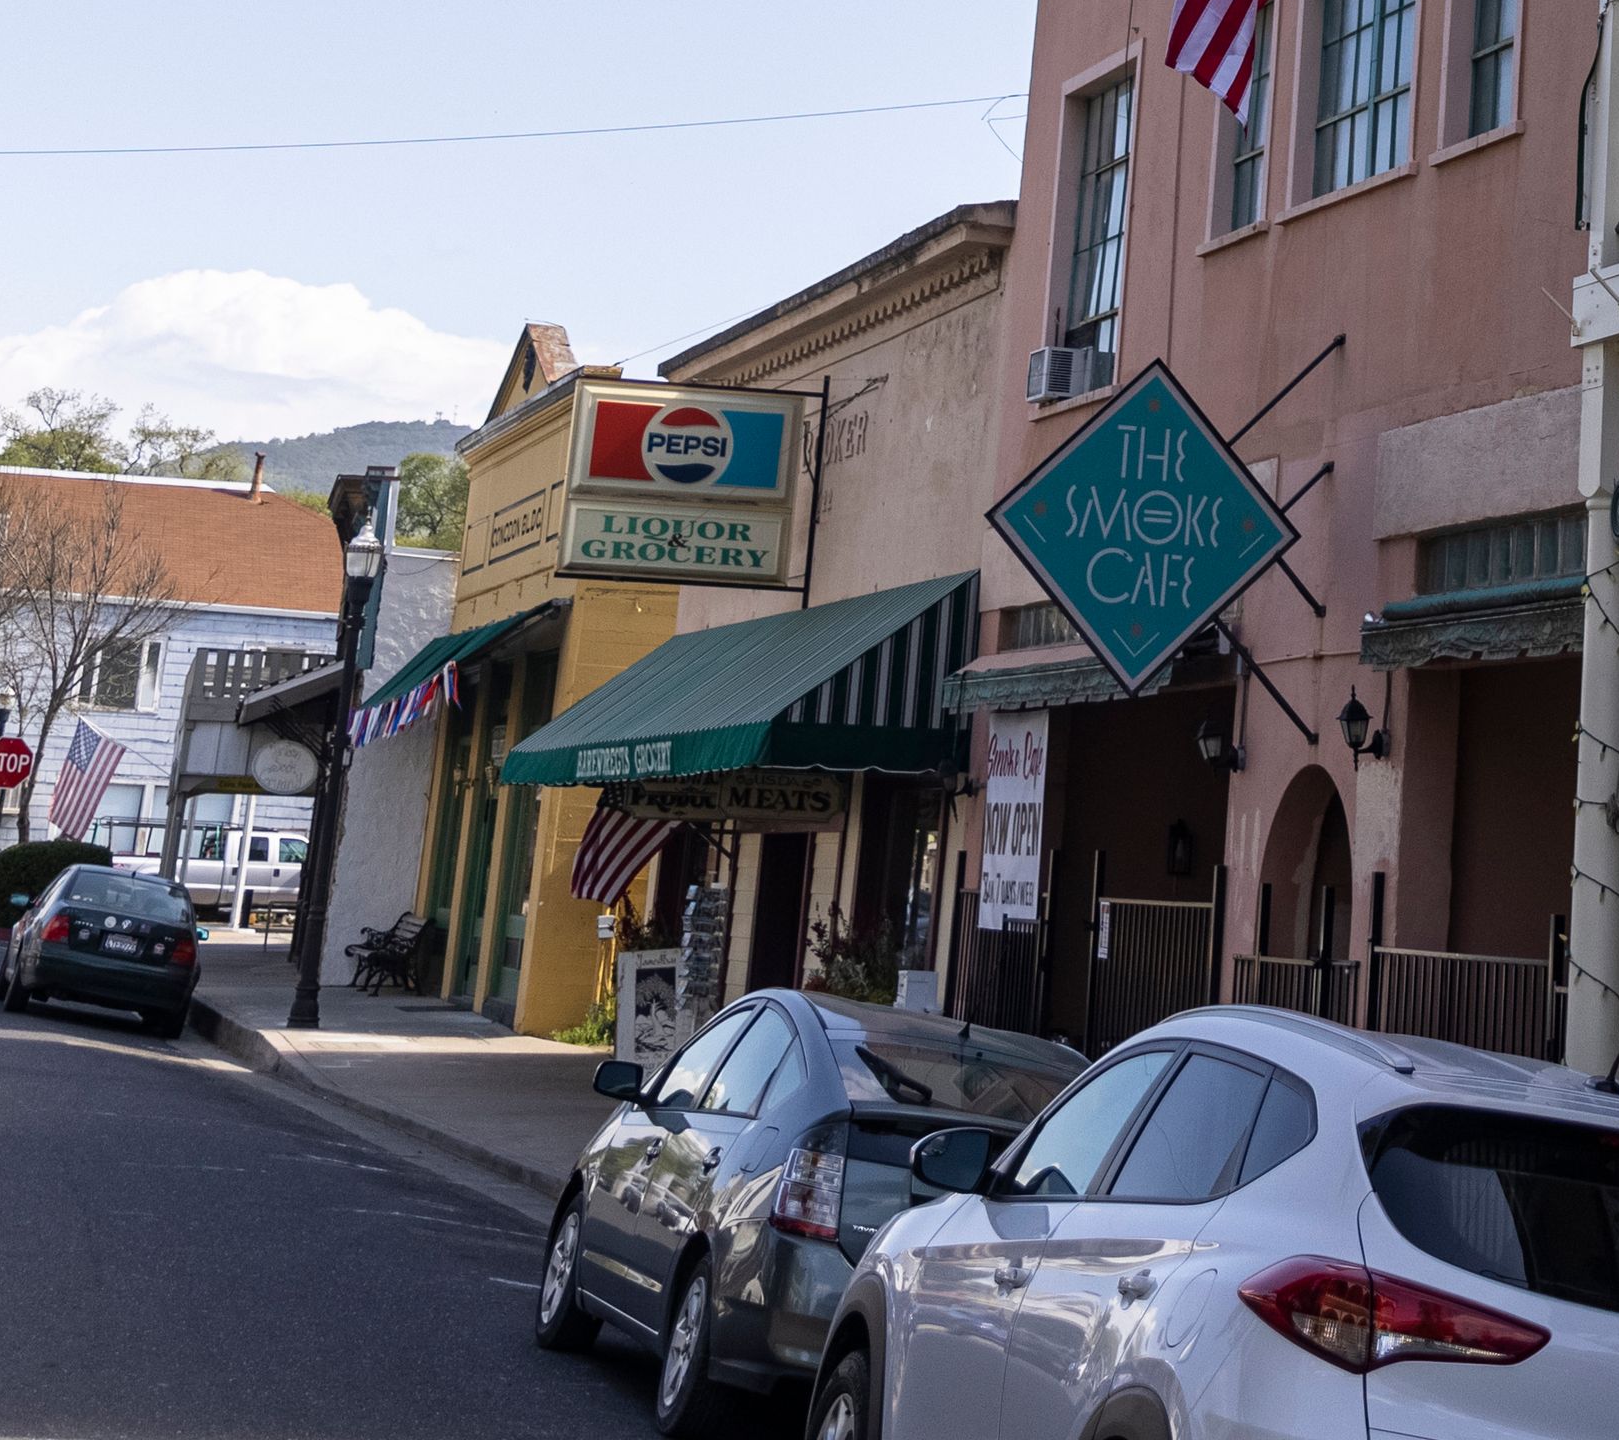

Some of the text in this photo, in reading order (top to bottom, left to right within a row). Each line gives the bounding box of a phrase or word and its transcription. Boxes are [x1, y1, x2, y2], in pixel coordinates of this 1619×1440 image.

[647, 432, 728, 458] PEPSI
[1118, 424, 1188, 482] THE
[601, 515, 751, 542] LIQUOR
[1065, 484, 1223, 549] SMOKE
[581, 539, 769, 568] GROCERY
[667, 533, 687, 548] &
[1087, 547, 1195, 609] CAFE
[634, 741, 672, 772] GROCERY
[987, 733, 1020, 780] Smoke
[729, 784, 832, 813] MEATS
[985, 802, 1042, 858] NOW OPEN
